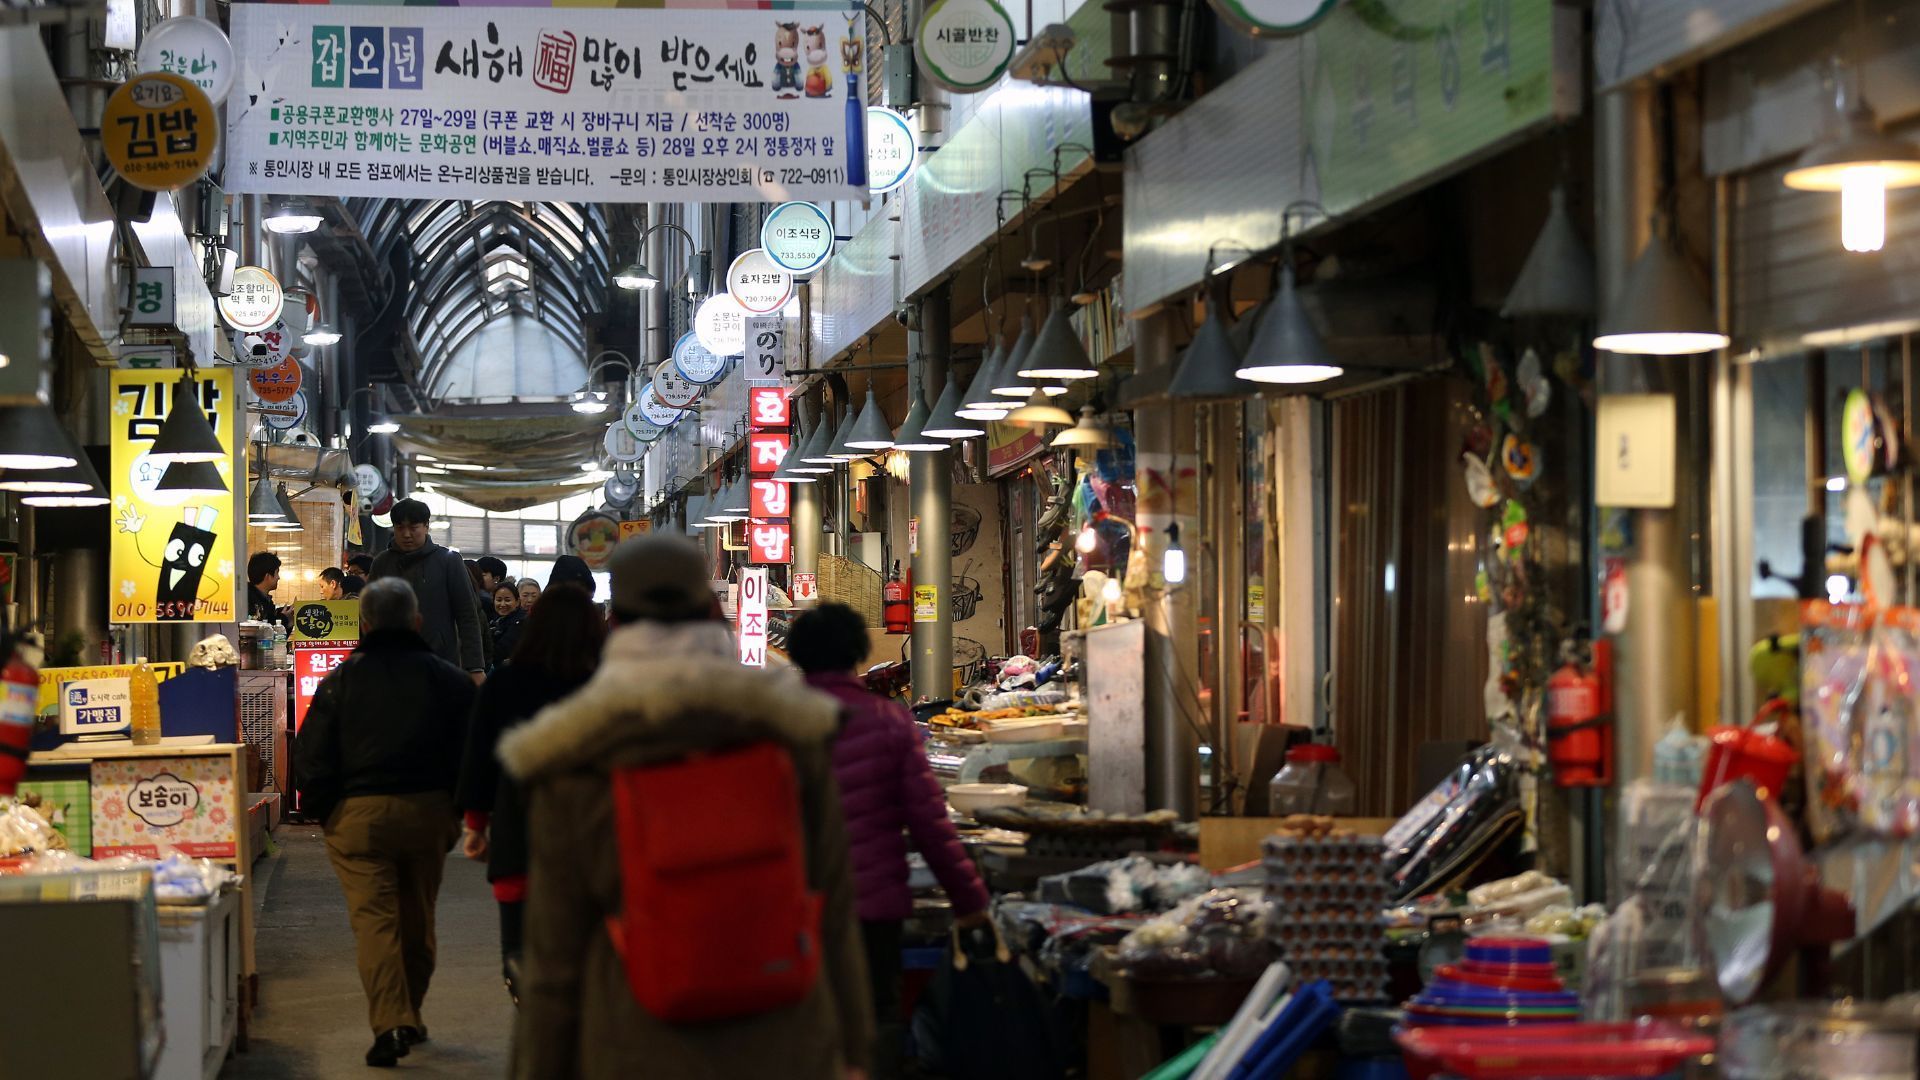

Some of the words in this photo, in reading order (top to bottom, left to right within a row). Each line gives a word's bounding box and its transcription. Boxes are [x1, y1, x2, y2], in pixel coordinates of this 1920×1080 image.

[935, 26, 999, 44] 시골반찬
[316, 33, 416, 83] 갑오년
[434, 21, 522, 83] 새해
[536, 31, 574, 90] 福
[582, 36, 642, 92] 많이
[660, 35, 764, 92] 받으세요
[281, 105, 395, 127] 공용쿠폰교환행사
[400, 108, 477, 130] 27일~29일
[483, 110, 518, 131] (쿠폰
[524, 110, 555, 131] 교환
[560, 111, 576, 132] 시
[581, 111, 640, 133] 장바구니
[645, 112, 674, 133] 지급
[695, 112, 738, 133] 선착순
[742, 112, 790, 134] 300명)
[117, 108, 199, 160] 김밥
[280, 130, 349, 151] 지역주민과
[353, 131, 413, 153] 함께하는
[418, 133, 477, 155] 문화공연
[635, 136, 656, 158] 등)
[661, 137, 696, 158] 28일
[701, 137, 730, 158] 오후
[735, 136, 758, 158] 2시
[763, 137, 817, 158] 정통정자
[821, 136, 834, 157] 앞
[263, 160, 315, 180] 통인시장
[318, 161, 331, 180] 내
[335, 161, 362, 180] 모든
[366, 162, 433, 183] 점포에서는
[437, 164, 532, 185] 온누리상품권을
[536, 166, 595, 186] 받습니다.
[662, 168, 752, 187] 통인시장상인회
[780, 168, 844, 187] 722-0911)
[776, 227, 822, 240] 이조식당
[739, 273, 782, 285] 효자김밥
[712, 312, 741, 322] 소문난
[755, 330, 778, 377] のり
[255, 371, 297, 385] 하우스
[751, 391, 789, 561] 효자김밥
[112, 693, 128, 701] cafe
[79, 708, 118, 724] 가맹점
[139, 784, 188, 809] 보솜이
